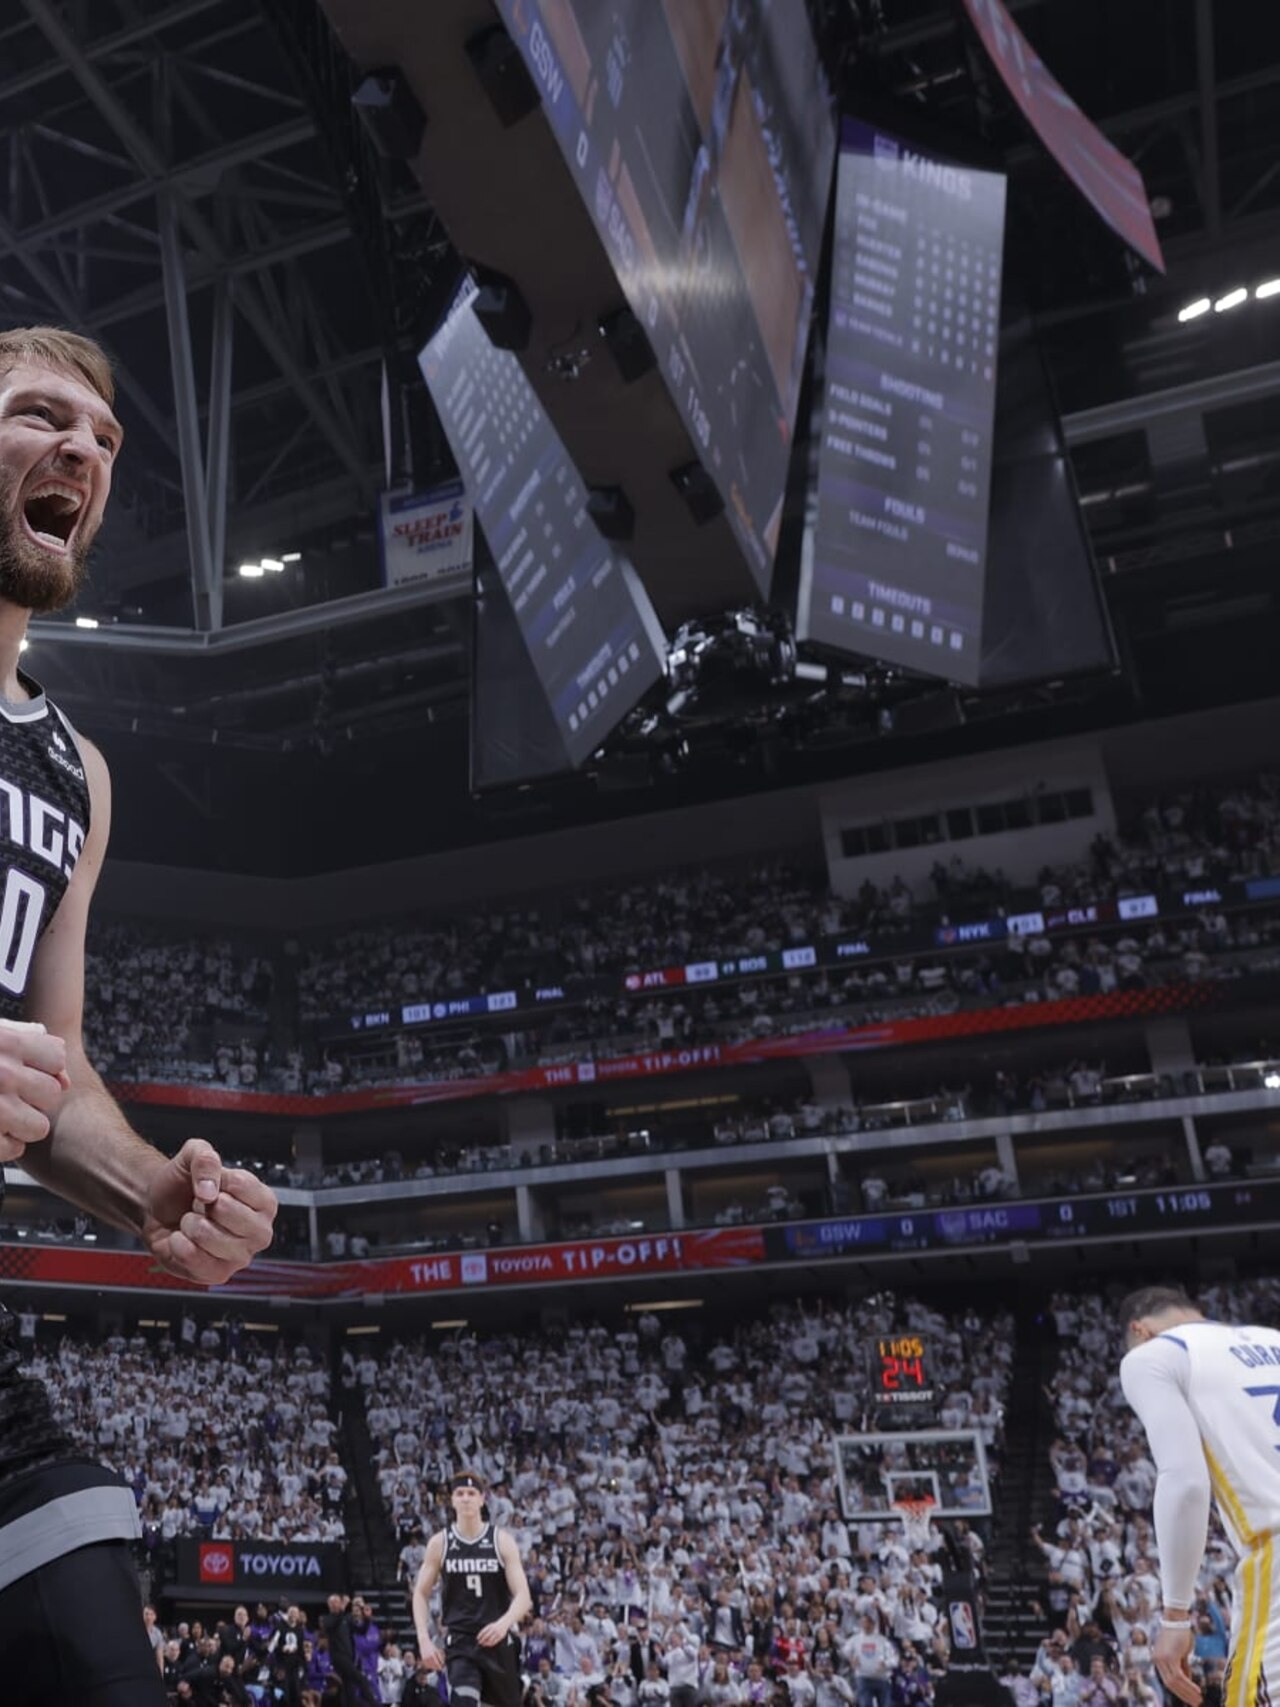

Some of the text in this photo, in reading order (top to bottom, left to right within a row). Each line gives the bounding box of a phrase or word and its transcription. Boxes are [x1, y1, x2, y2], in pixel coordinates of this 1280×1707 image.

[529, 20, 564, 104] GSW
[1067, 906, 1098, 924] CLE
[643, 970, 668, 987] ATL
[448, 1000, 470, 1014] PHI
[967, 1210, 1009, 1230] SAC
[820, 1223, 862, 1243] GSW
[410, 1238, 681, 1284] THE TOYOTA TIP-OFF!
[882, 1355, 924, 1389] 24
[239, 1552, 321, 1577] TOYOTA
[445, 1558, 499, 1574] KINGS
[466, 1574, 483, 1598] 9
